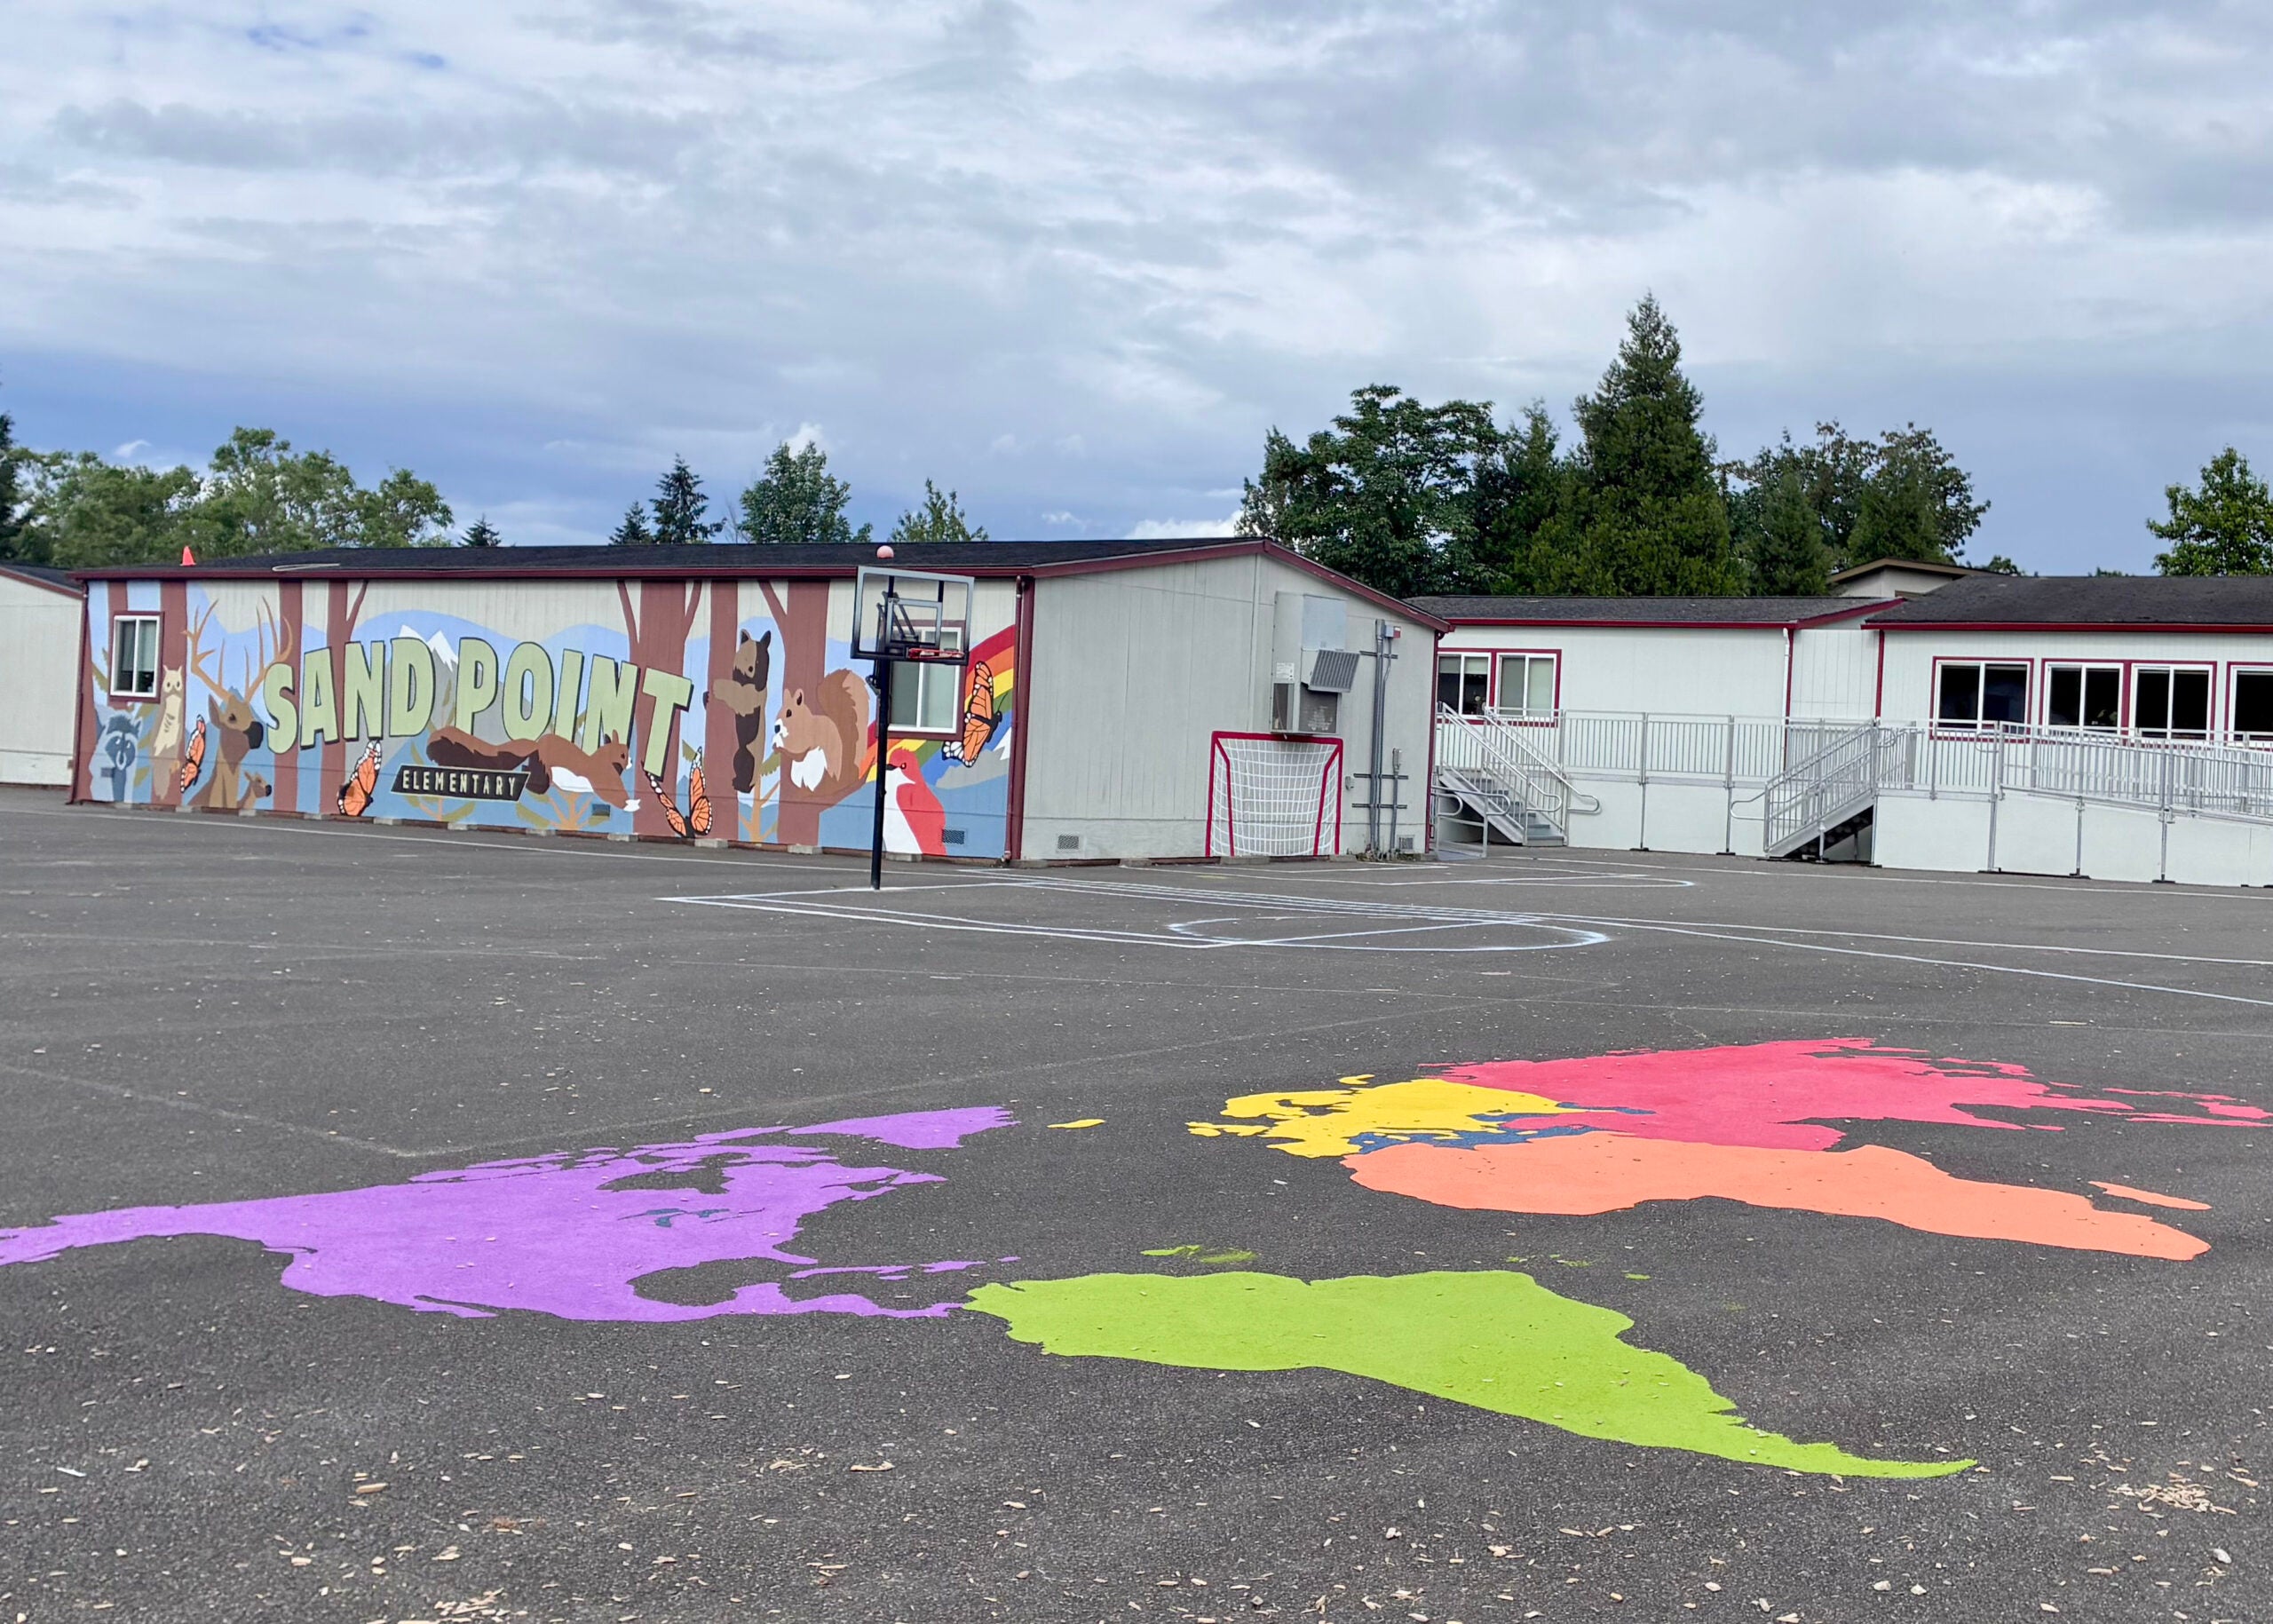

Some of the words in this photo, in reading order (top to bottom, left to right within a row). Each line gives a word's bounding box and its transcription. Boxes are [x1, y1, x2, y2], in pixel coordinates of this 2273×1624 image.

[264, 637, 435, 754] SAND
[455, 637, 693, 781] POINT
[402, 770, 516, 796] ELEMENTARY
